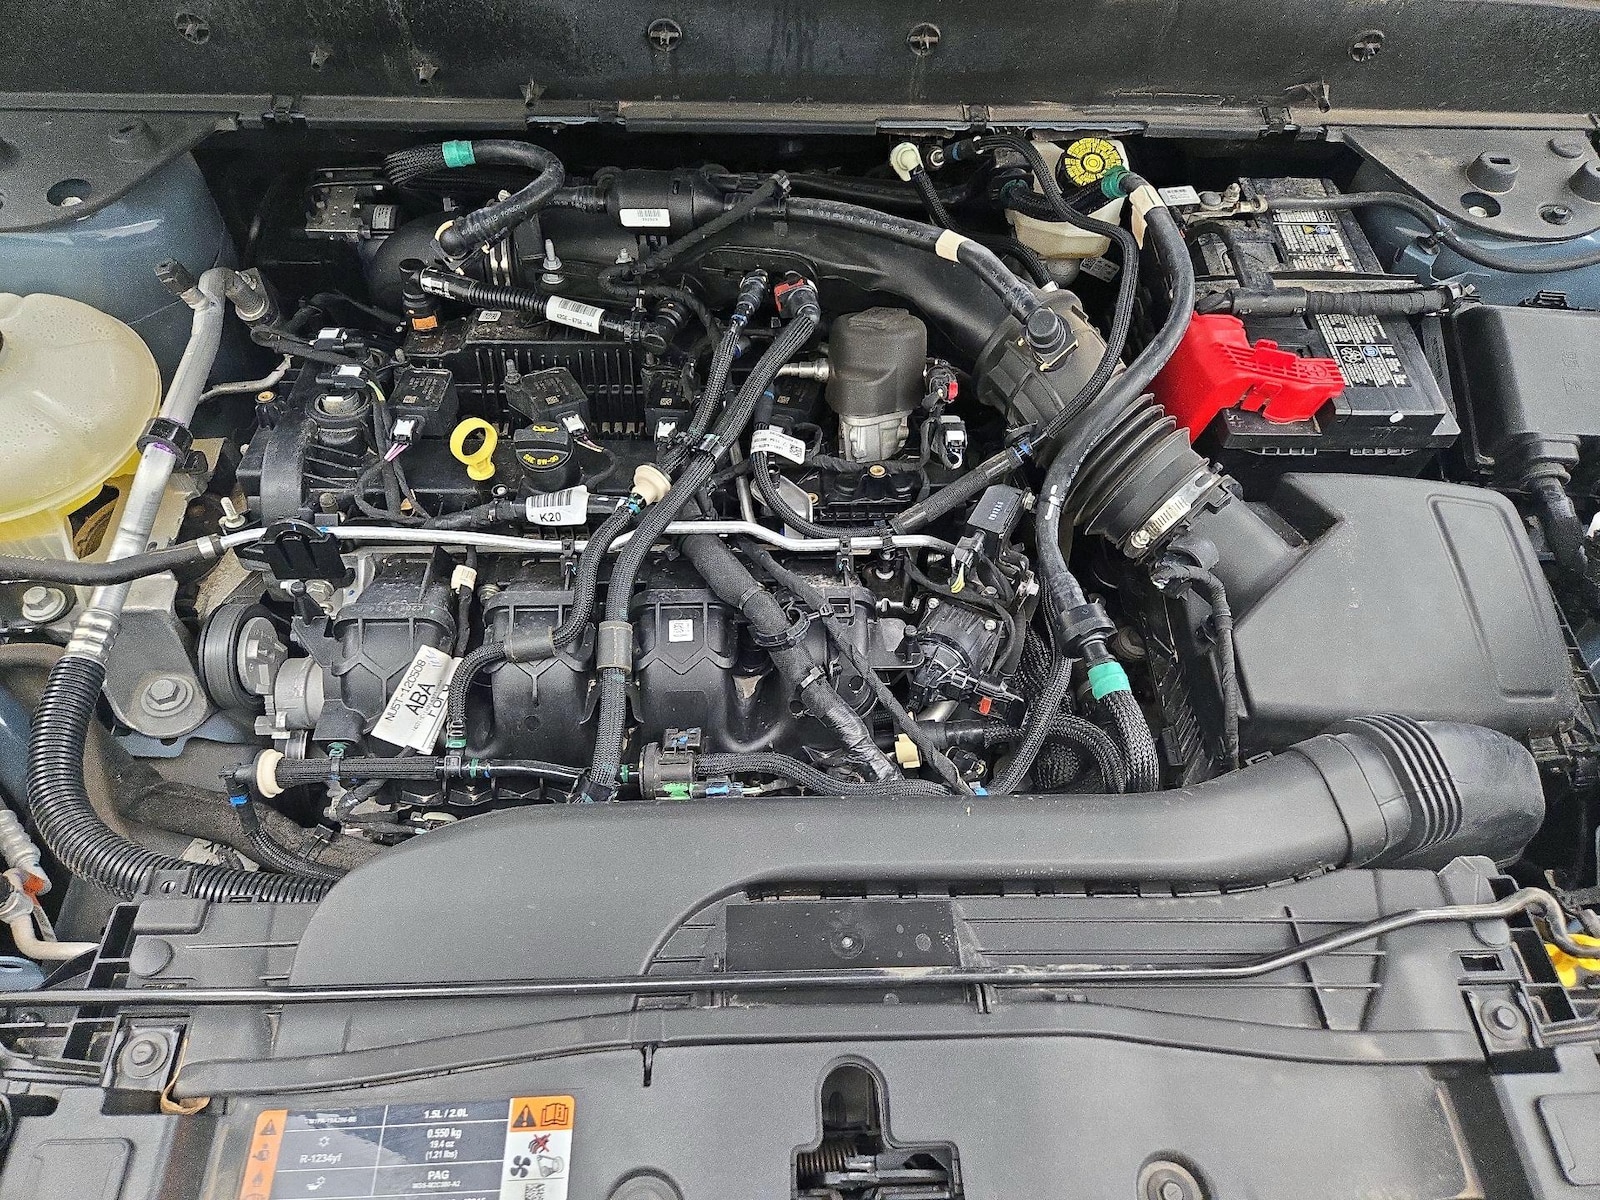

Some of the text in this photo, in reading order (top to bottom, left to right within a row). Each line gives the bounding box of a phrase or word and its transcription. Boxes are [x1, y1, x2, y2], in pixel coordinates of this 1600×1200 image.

[522, 453, 535, 464] SAE
[539, 511, 561, 522] K20
[384, 659, 427, 722] NU5T-12C508
[404, 683, 436, 716] ABA
[424, 1109, 442, 1119] 1.5L
[449, 1108, 469, 1118] 2.0L
[426, 1127, 463, 1140] 0.550 kg
[429, 1140, 456, 1149] 19.4 oz
[299, 1153, 343, 1165] R-1234yf
[425, 1150, 459, 1161] (1.21 lbs)
[427, 1170, 450, 1181] PAG
